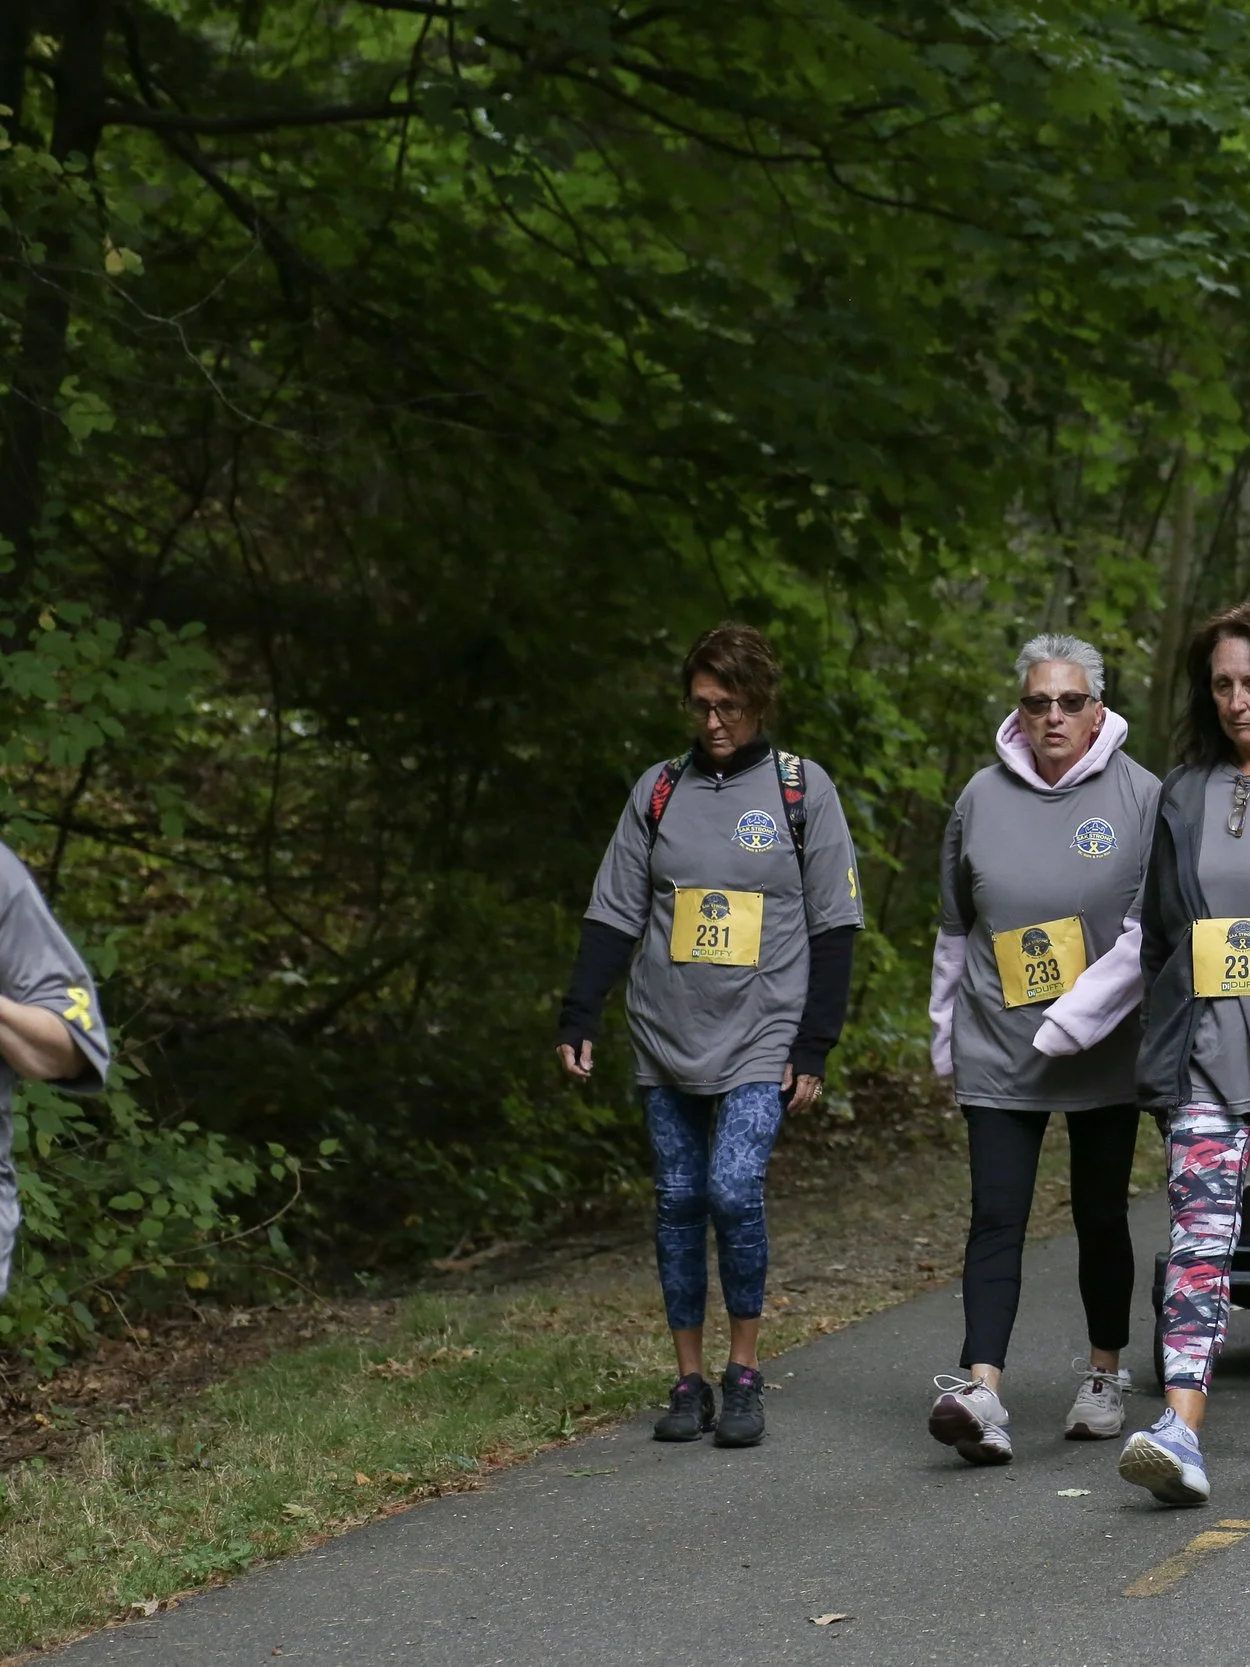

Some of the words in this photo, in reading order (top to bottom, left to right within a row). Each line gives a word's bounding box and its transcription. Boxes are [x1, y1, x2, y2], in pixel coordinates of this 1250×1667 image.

[751, 826, 775, 835] STRONG
[1077, 833, 1089, 841] SAK
[1089, 833, 1113, 842] STRONG
[696, 924, 730, 948] 231
[700, 948, 733, 957] DUFFY
[1025, 958, 1060, 986] 233
[1036, 982, 1065, 994] DUFFY
